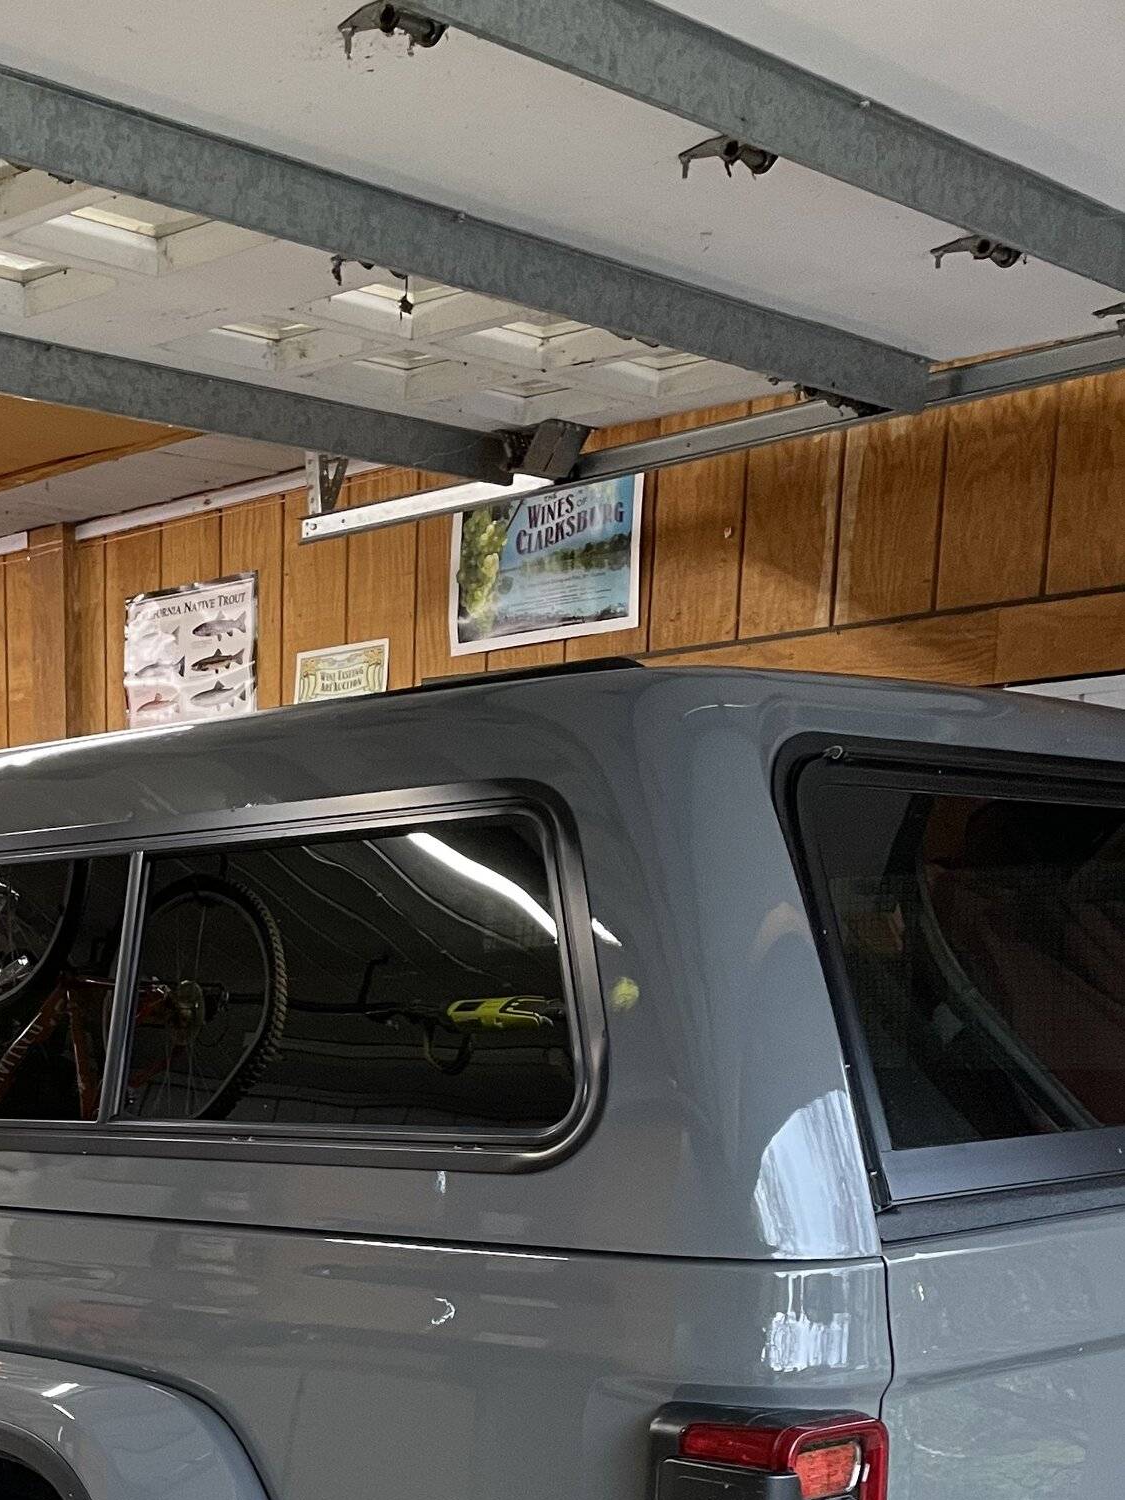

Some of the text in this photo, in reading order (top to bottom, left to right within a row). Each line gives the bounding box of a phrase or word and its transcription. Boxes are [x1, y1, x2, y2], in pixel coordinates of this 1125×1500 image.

[515, 501, 625, 555] CLARKSBURG
[528, 494, 575, 530] WINES
[184, 598, 216, 614] NATIVE
[218, 591, 246, 607] TROUT
